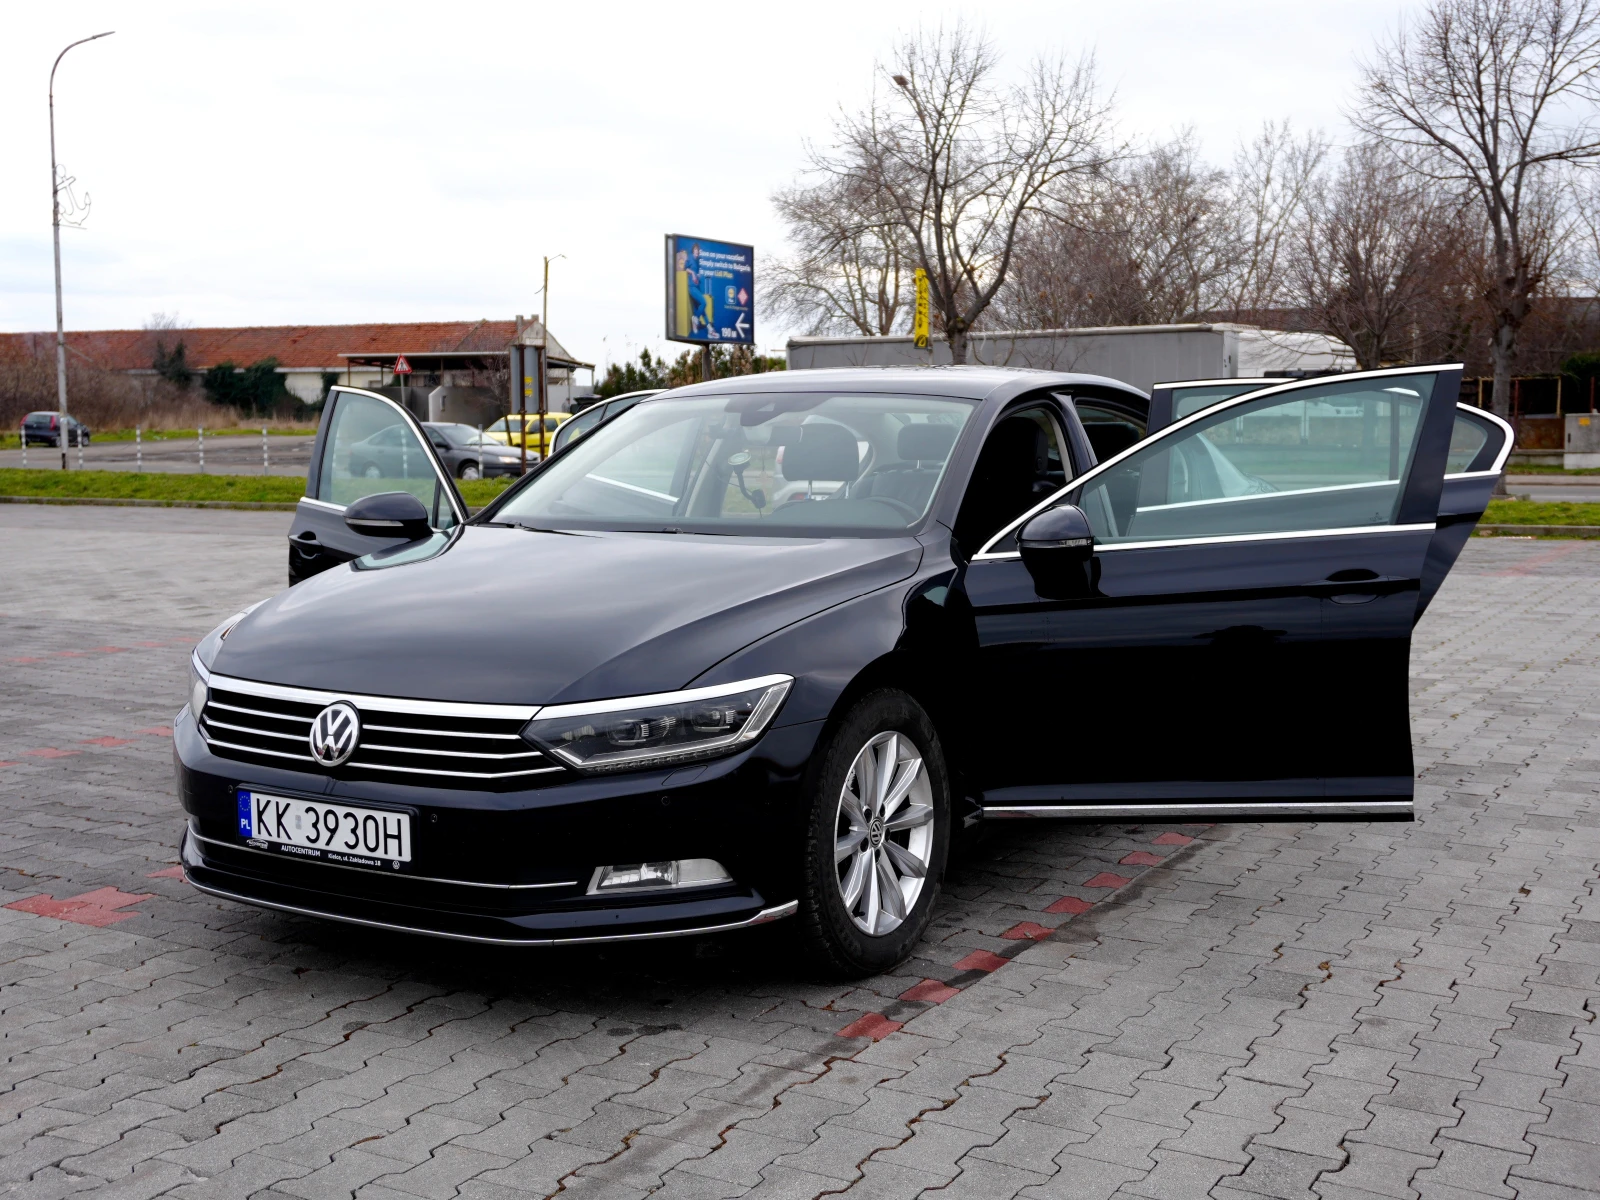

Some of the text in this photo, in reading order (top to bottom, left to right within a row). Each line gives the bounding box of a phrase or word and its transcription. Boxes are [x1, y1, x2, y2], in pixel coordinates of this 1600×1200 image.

[726, 254, 745, 262] vacation!
[699, 258, 714, 268] Simply
[714, 261, 728, 269] switch
[733, 262, 751, 272] Bulgaria
[722, 327, 731, 338] 190
[241, 818, 250, 829] PL
[256, 798, 403, 858] KK 3930H
[281, 845, 320, 857] AUTOCENTRUM
